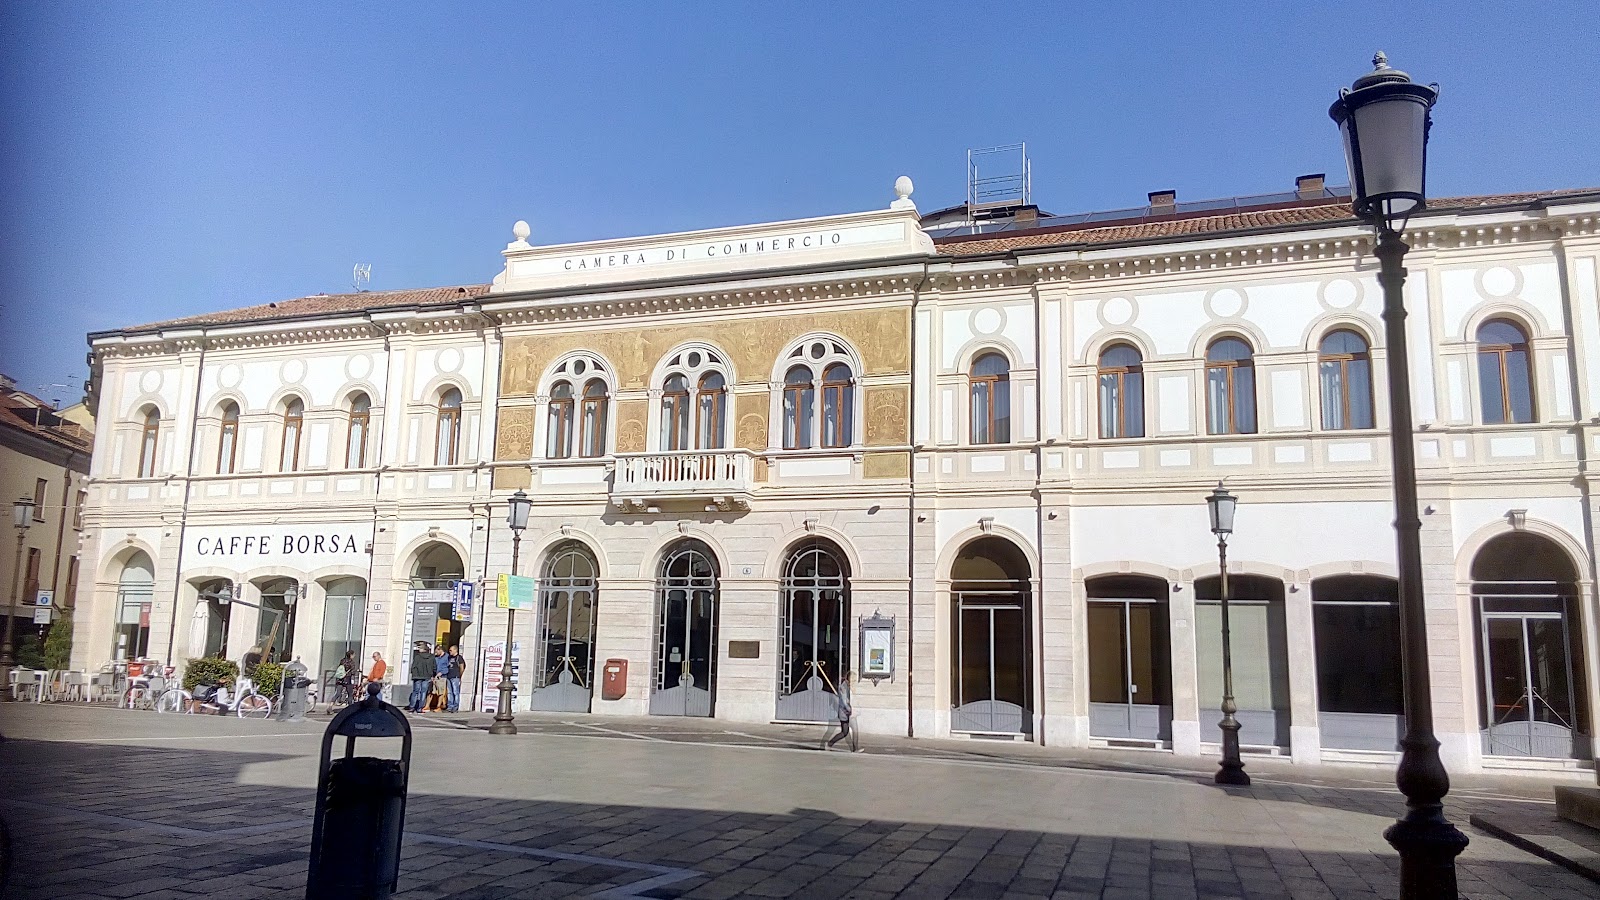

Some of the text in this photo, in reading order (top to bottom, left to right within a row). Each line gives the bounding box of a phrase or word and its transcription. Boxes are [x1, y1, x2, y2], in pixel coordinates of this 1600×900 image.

[564, 232, 841, 271] CAMERA DI COMMERCIO
[282, 534, 358, 555] BORSA
